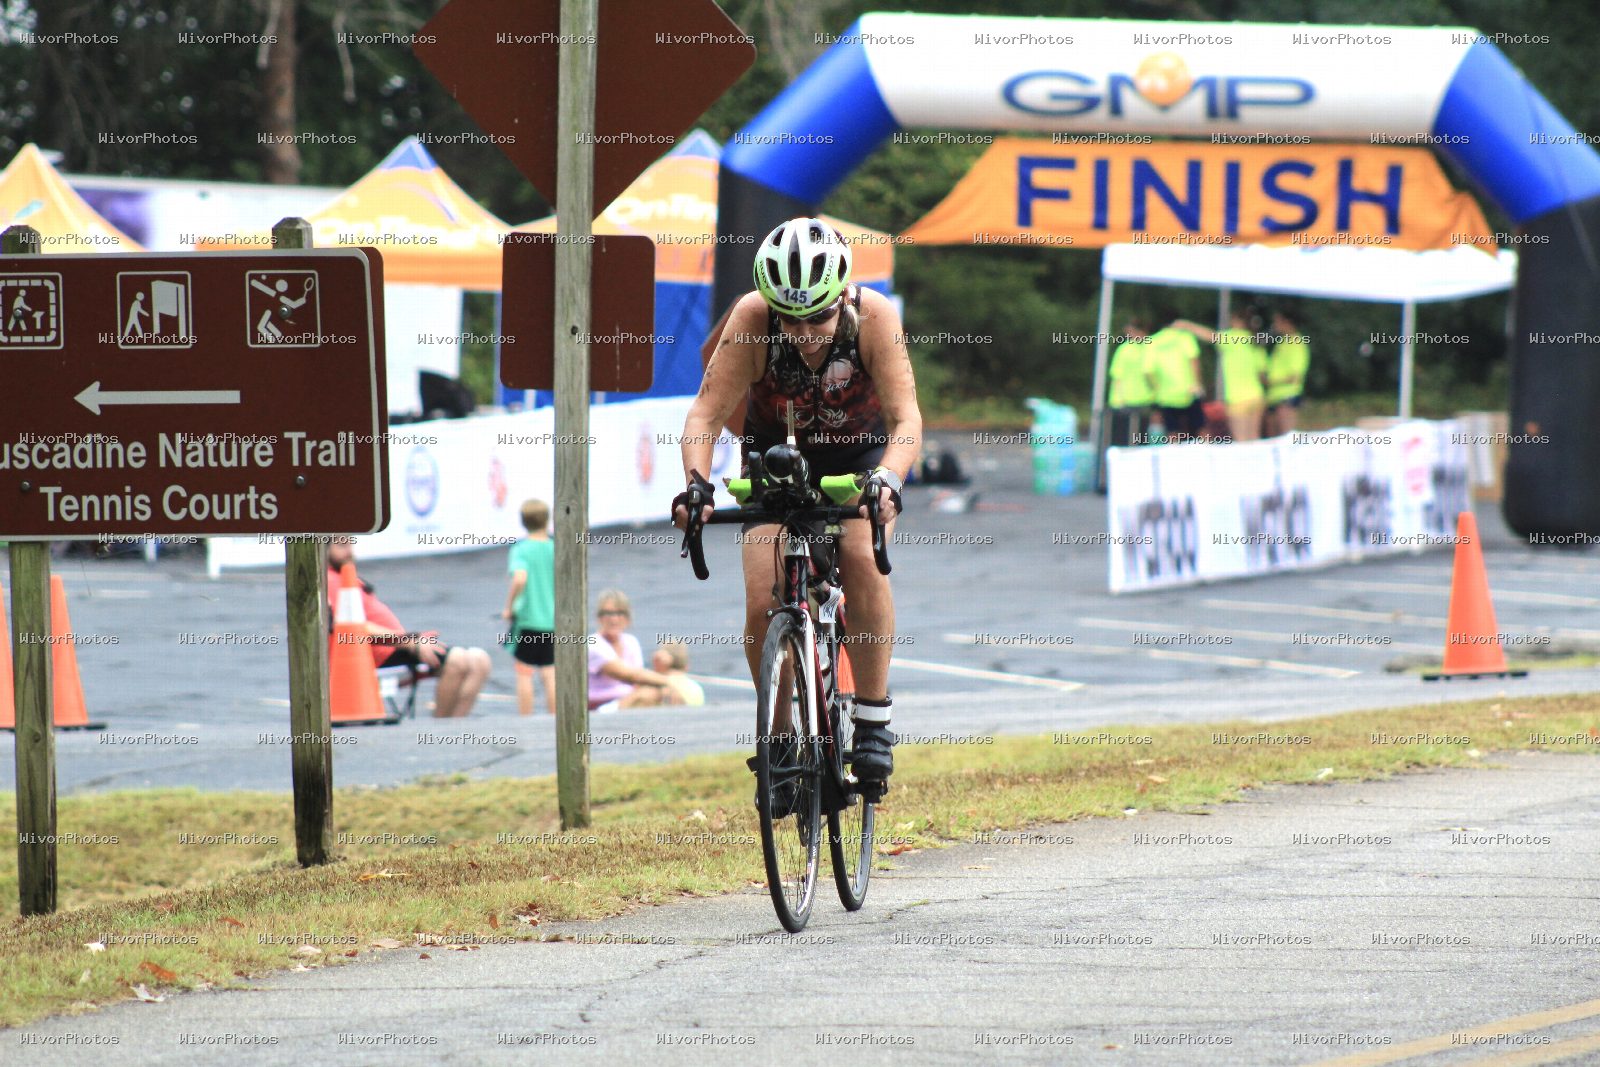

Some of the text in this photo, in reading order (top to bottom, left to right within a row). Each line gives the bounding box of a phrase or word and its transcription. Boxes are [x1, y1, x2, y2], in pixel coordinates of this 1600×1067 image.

[1001, 69, 1317, 120] GMP
[1017, 156, 1404, 236] FINISH
[783, 288, 808, 304] 145
[159, 432, 274, 468] Nature
[284, 432, 356, 467] Trail
[40, 484, 279, 522] Tennis Courts
